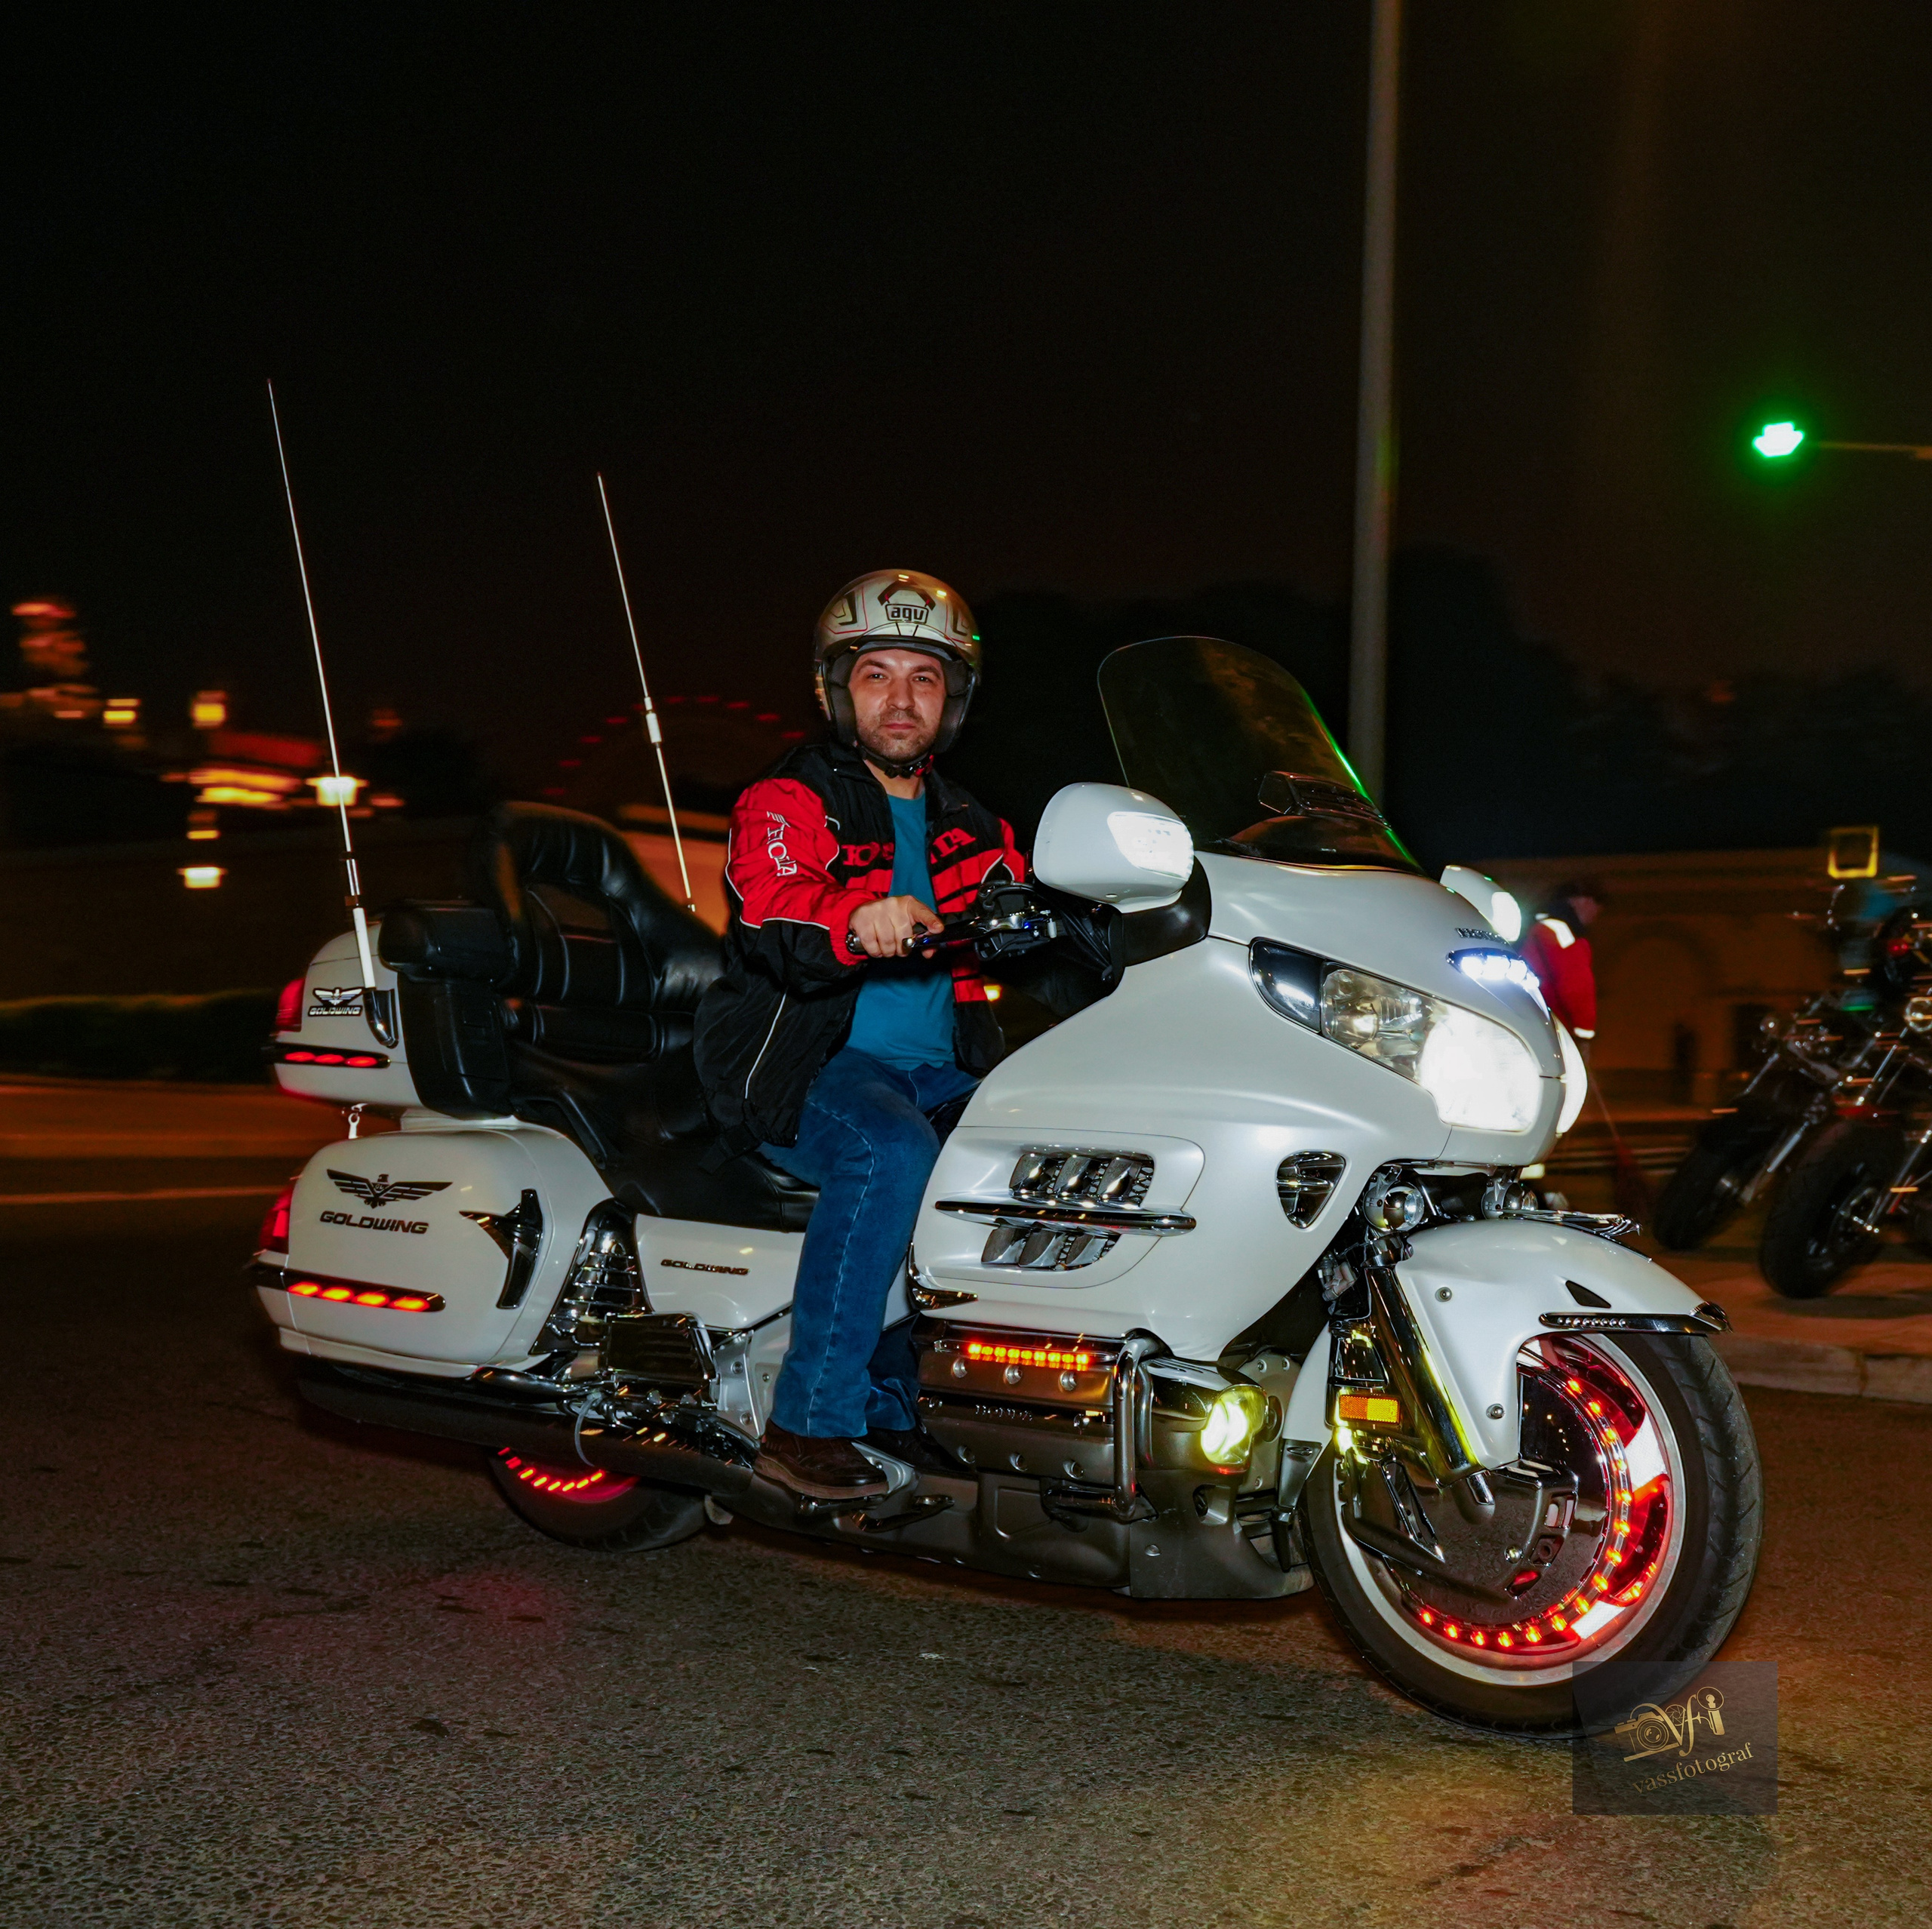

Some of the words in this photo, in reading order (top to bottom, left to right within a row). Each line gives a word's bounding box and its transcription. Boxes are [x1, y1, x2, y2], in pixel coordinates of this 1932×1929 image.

[309, 1006, 361, 1016] GOLDWING
[320, 1211, 429, 1234] GOLDWING
[660, 1259, 749, 1275] GOLDWING
